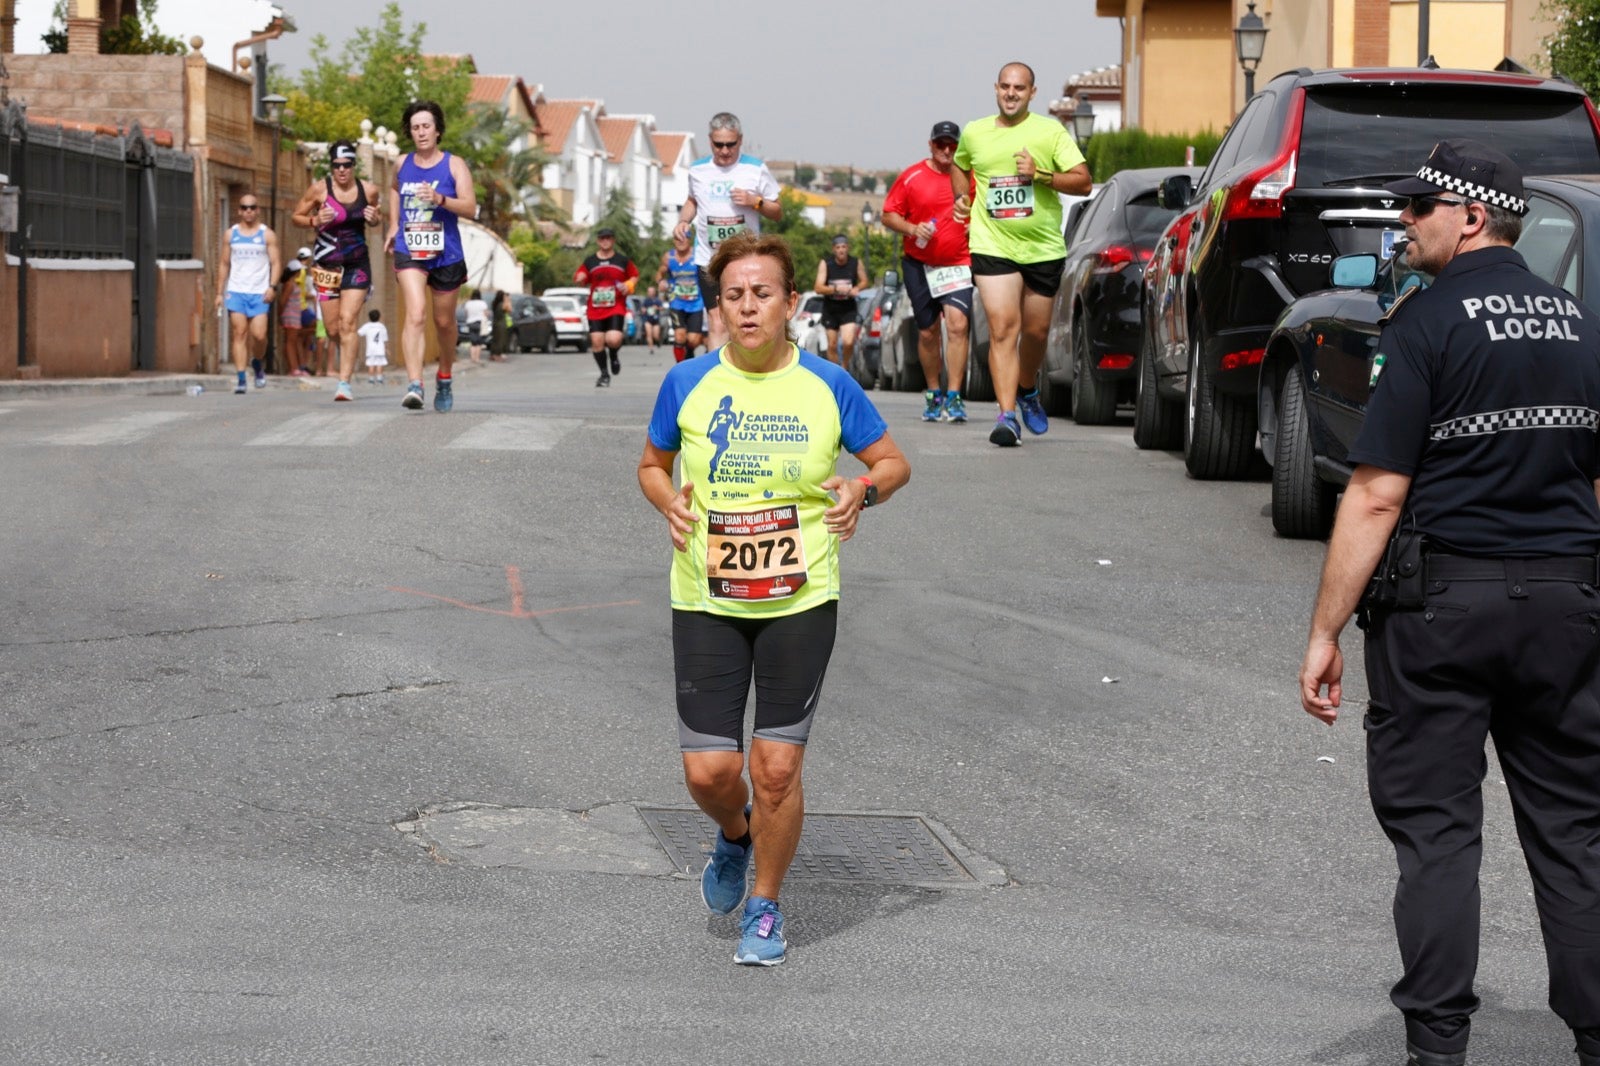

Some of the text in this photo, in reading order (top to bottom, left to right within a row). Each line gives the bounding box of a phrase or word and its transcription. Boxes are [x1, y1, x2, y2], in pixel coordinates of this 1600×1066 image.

[994, 188, 1026, 206] 360
[407, 233, 440, 246] 3018
[1461, 294, 1583, 320] POLICIA
[1485, 317, 1580, 342] LOCAL
[746, 414, 800, 423] CARRERA
[743, 423, 809, 432] SOLIDARIA
[730, 431, 809, 442] LUX MUNDI
[725, 453, 770, 462] MUÉVETE
[721, 460, 761, 468] CONTRA
[716, 475, 756, 484] JUVENIL
[724, 514, 742, 525] GRAN
[743, 513, 764, 525] PREMIO
[765, 511, 773, 522] DE
[773, 508, 793, 521] FONDO
[719, 536, 799, 571] 2072
